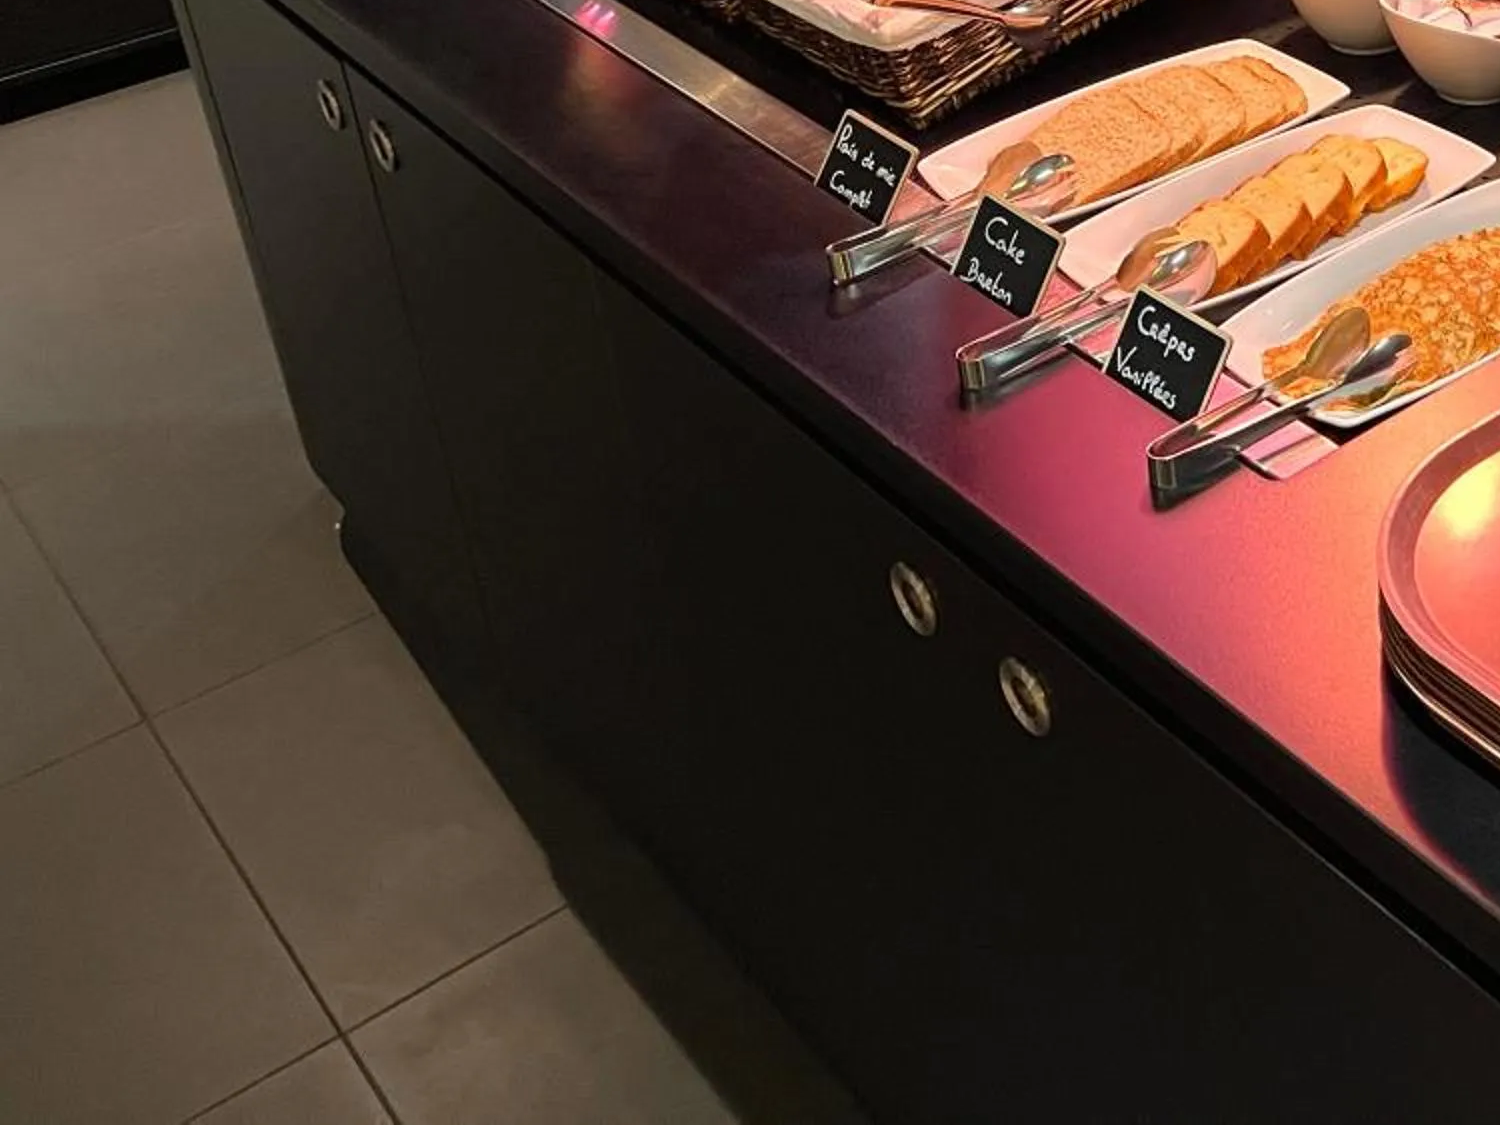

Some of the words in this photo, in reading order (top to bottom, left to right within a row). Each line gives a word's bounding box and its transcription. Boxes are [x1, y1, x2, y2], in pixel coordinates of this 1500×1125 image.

[836, 123, 858, 162] Pain
[861, 151, 875, 171] de
[876, 166, 896, 187] mie
[829, 170, 873, 209] Complet
[985, 216, 1025, 265] Cake
[959, 257, 1013, 306] Breton
